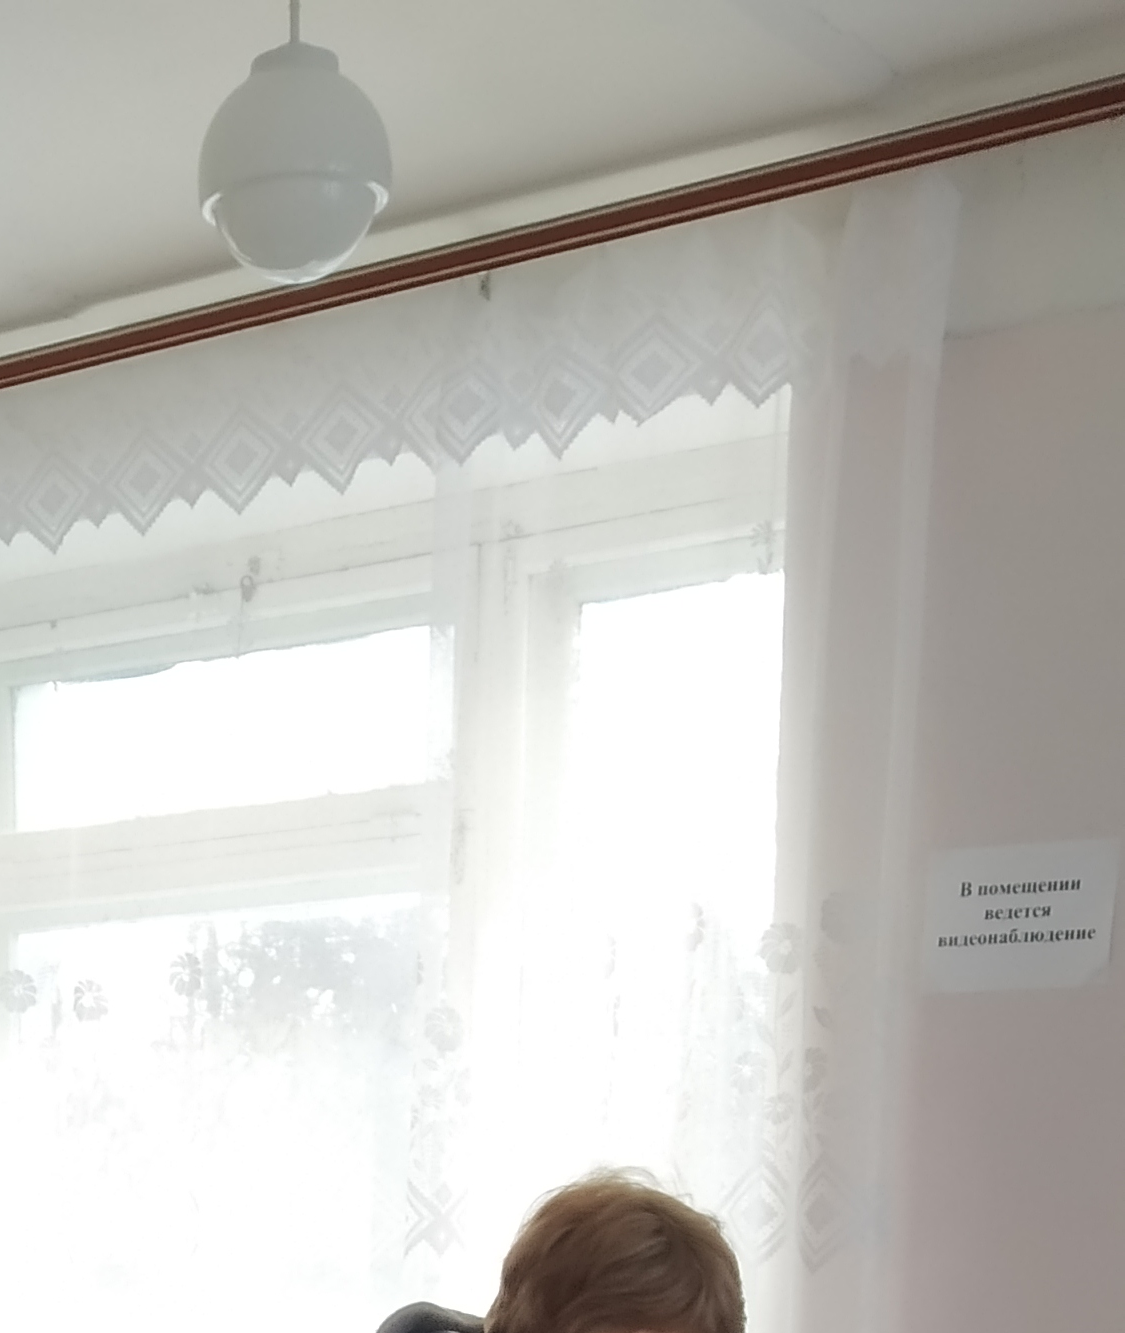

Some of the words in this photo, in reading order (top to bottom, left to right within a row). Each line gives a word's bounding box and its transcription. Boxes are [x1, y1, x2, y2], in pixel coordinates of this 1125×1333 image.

[960, 881, 972, 897] В
[978, 878, 1081, 896] помещении
[984, 905, 1051, 920] ведется
[938, 927, 1096, 947] видеонаблюдение
